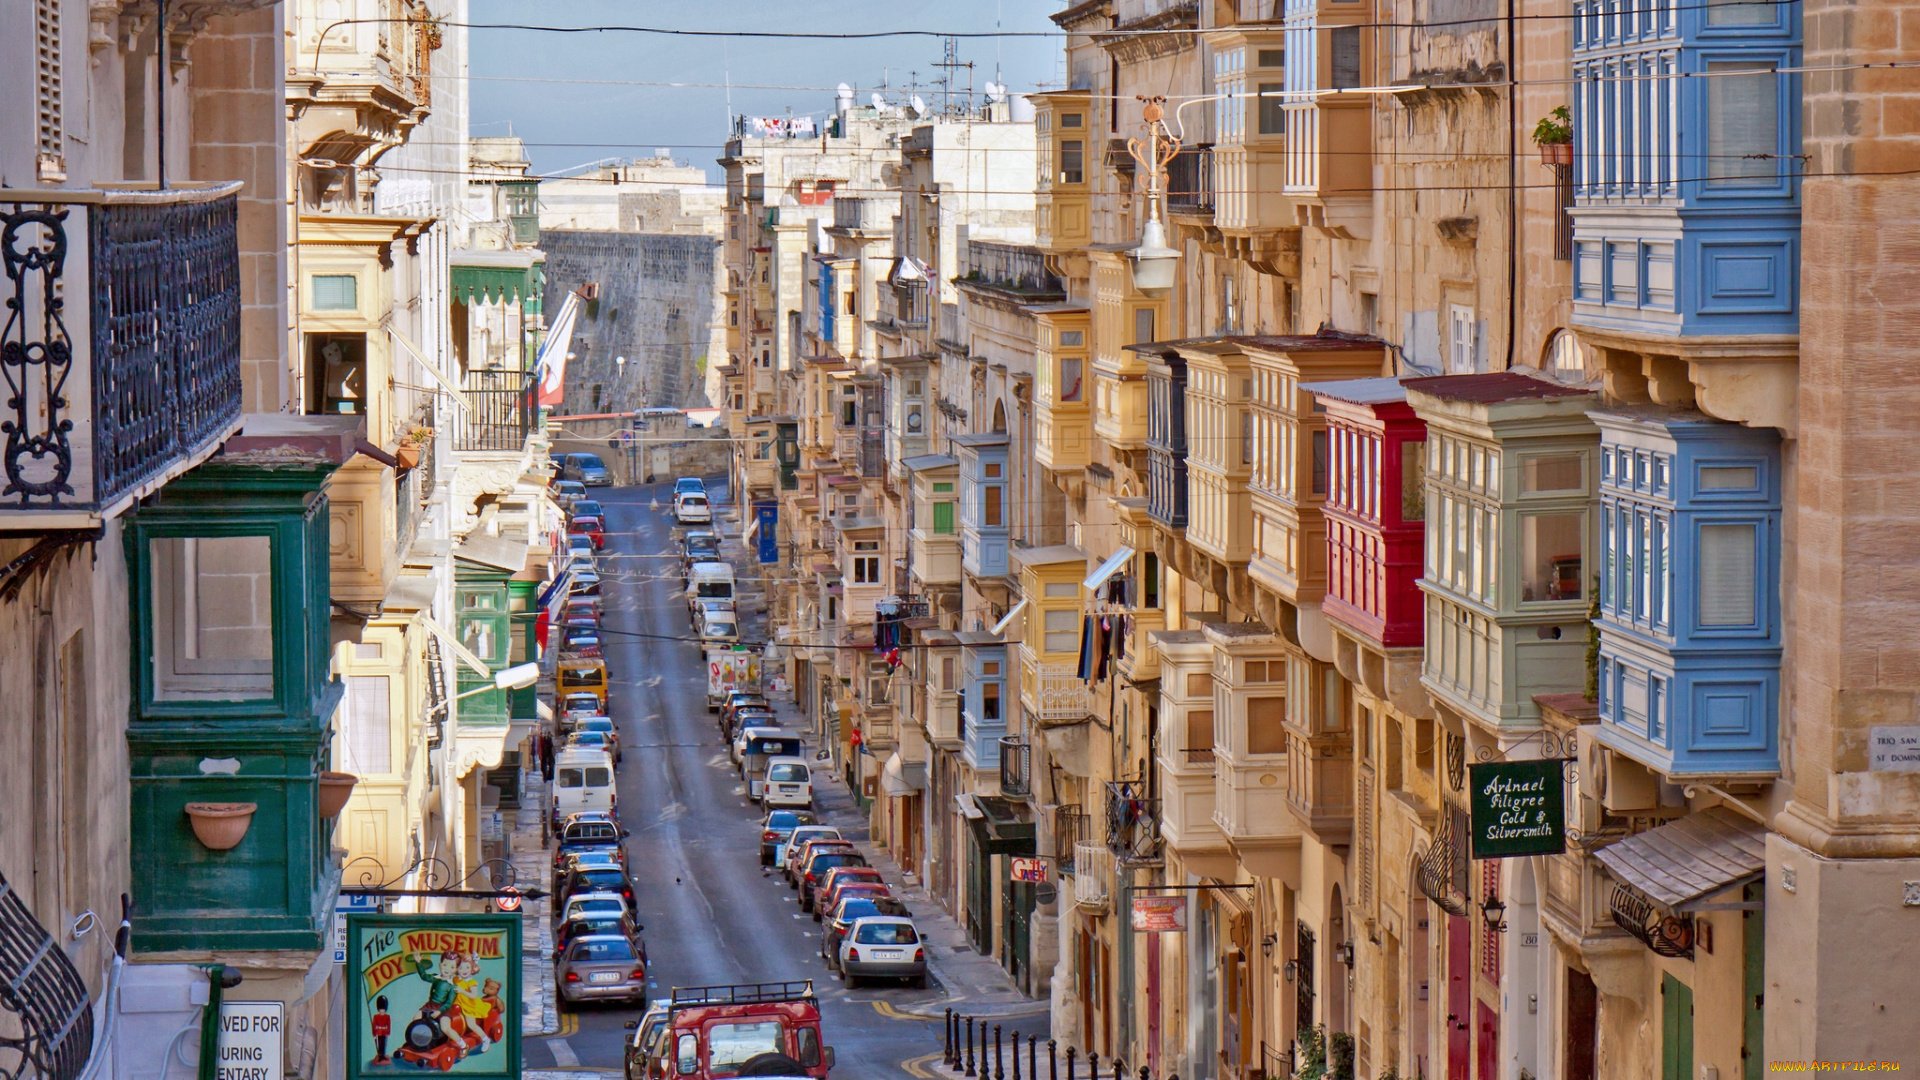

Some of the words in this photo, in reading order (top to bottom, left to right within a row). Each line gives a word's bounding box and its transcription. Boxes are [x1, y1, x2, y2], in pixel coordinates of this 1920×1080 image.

[1877, 737, 1896, 745] TRIQ
[1900, 737, 1917, 745] SAN
[1876, 754, 1885, 762] ST
[1484, 775, 1544, 795] Ardnael
[1491, 794, 1544, 811] Filigree
[1500, 811, 1527, 825] Gold
[1536, 810, 1545, 824] &
[1486, 823, 1552, 839] Silversmith
[364, 930, 394, 964] The
[407, 933, 499, 956] MUSEUM
[368, 956, 403, 988] TOY
[253, 1016, 279, 1032] FOR
